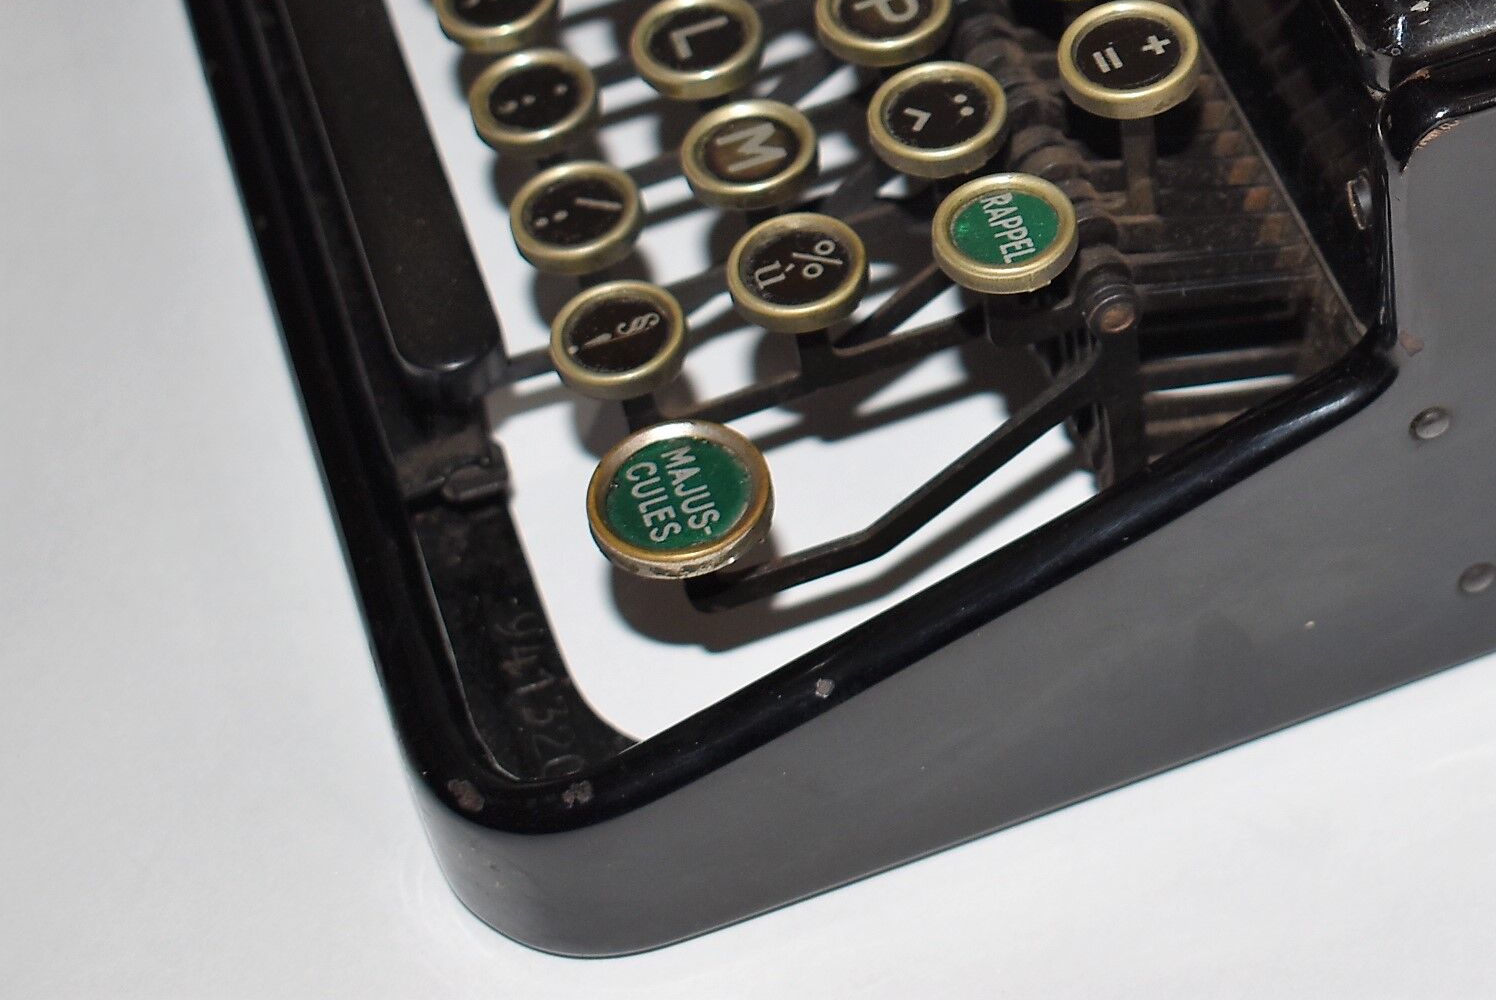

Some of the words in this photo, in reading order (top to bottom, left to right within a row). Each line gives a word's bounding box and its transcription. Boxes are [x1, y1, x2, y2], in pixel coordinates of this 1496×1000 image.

[669, 16, 729, 60] L
[715, 123, 788, 173] M
[980, 192, 1035, 264] RAPPEL
[753, 262, 796, 292] ù
[792, 239, 844, 279] %
[625, 461, 681, 543] CULES
